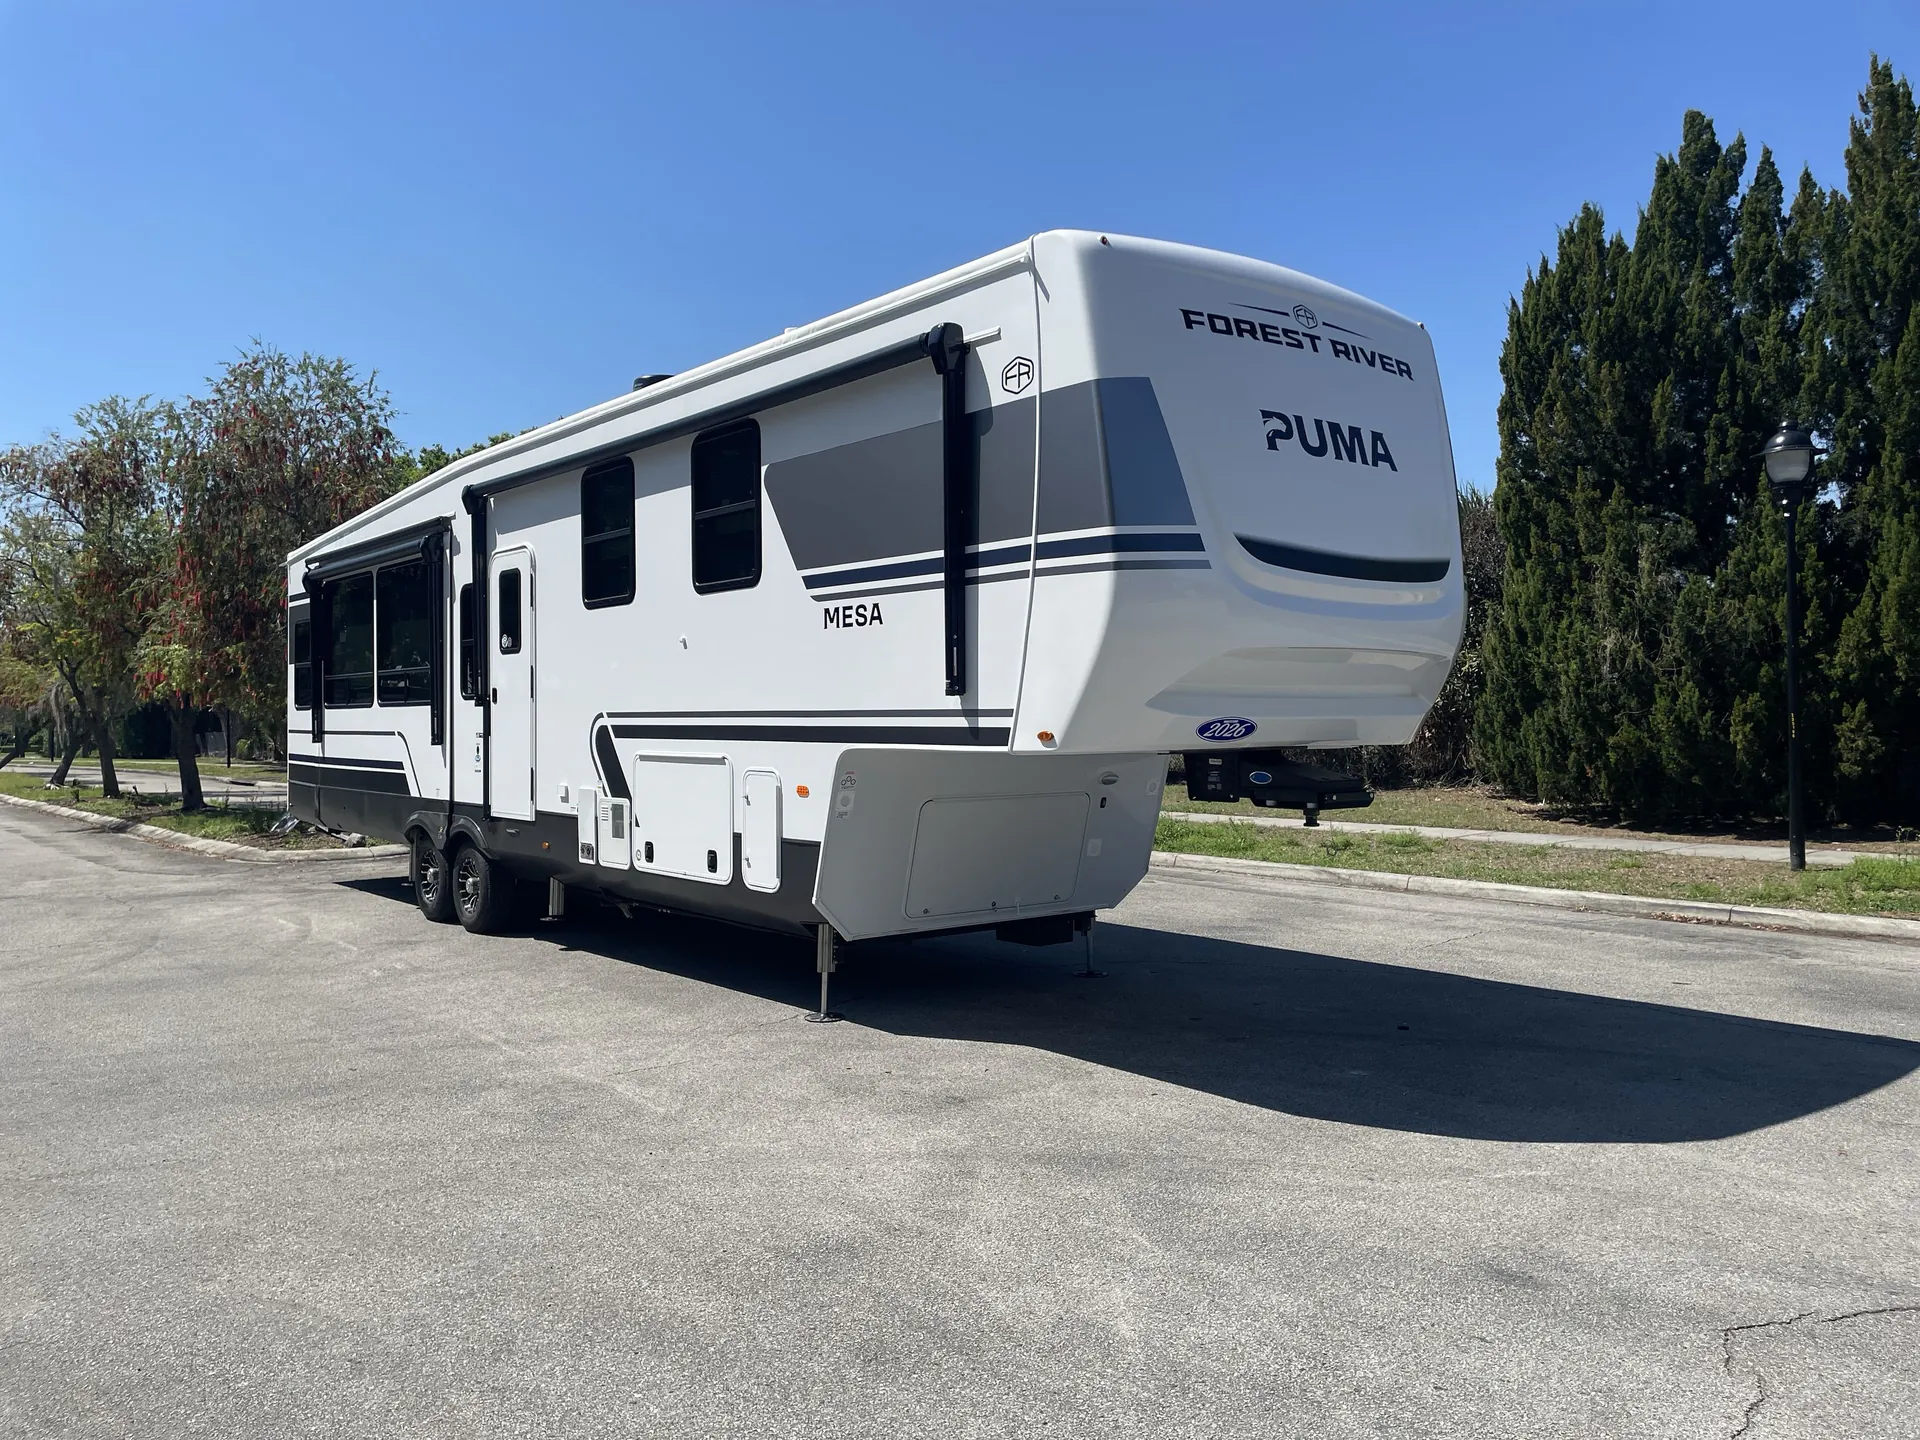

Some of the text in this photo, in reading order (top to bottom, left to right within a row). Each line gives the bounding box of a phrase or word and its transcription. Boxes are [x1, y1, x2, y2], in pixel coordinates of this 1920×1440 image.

[1179, 308, 1414, 381] FOREST RIVER
[1004, 360, 1031, 390] FR
[1259, 409, 1398, 472] PUMA
[823, 602, 884, 630] MESA
[1203, 722, 1251, 737] 2026
